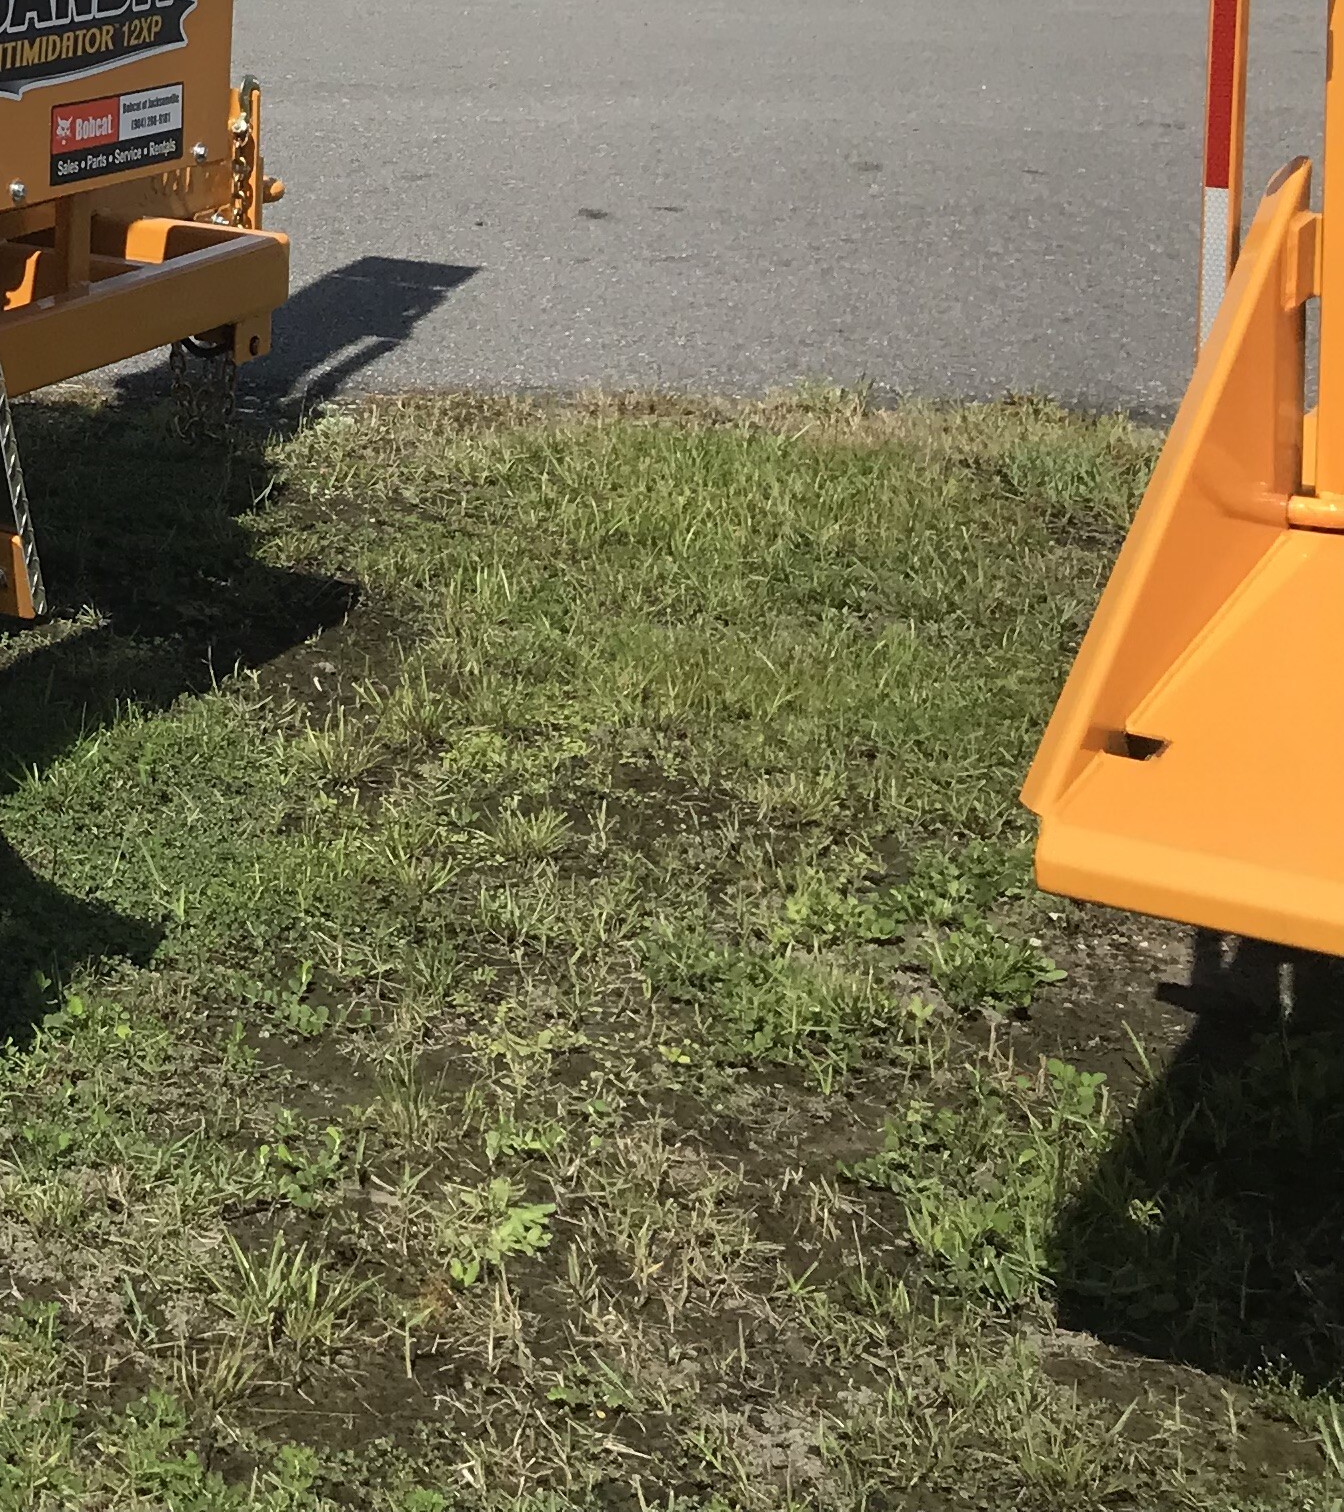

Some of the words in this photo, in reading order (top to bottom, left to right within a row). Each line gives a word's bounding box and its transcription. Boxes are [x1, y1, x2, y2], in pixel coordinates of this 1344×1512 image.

[122, 15, 162, 47] 12XP
[122, 101, 142, 114] Bobcat
[75, 114, 113, 141] Bobcat
[57, 159, 79, 176] Sales
[87, 153, 108, 170] Parts
[114, 146, 143, 164] Service
[149, 138, 177, 157] Rentals
